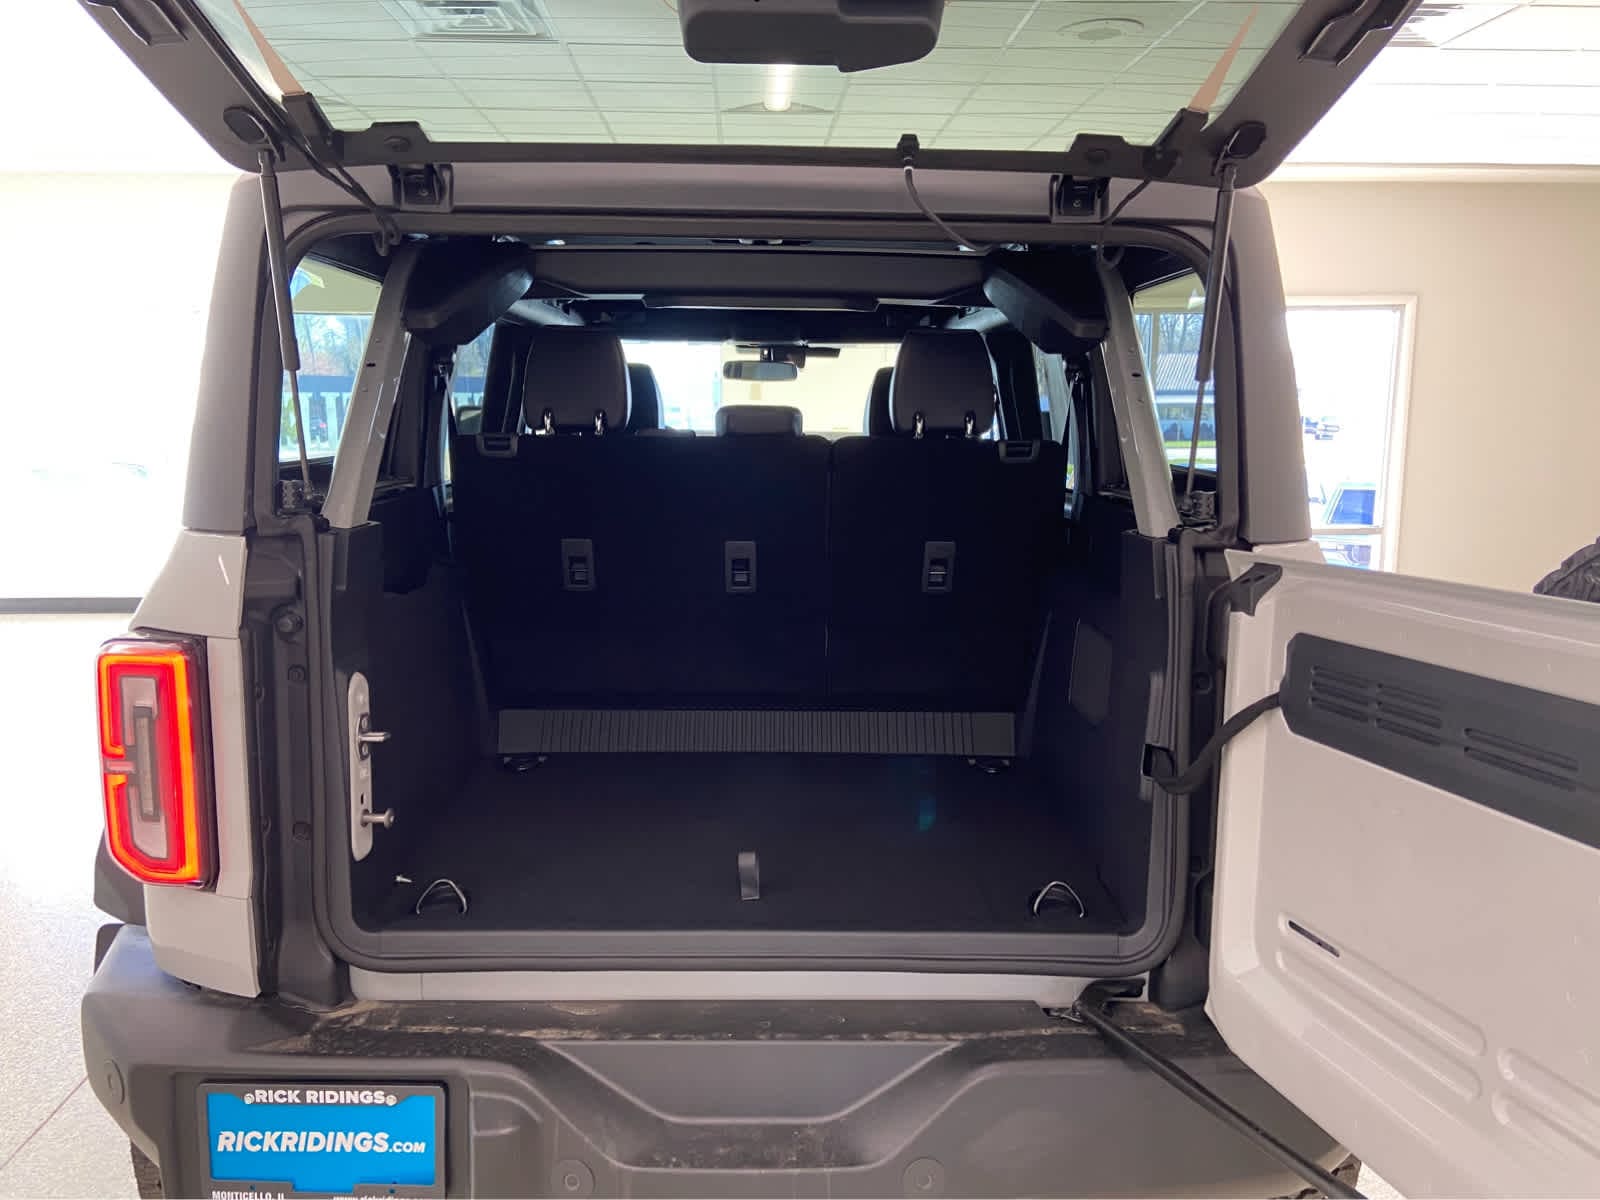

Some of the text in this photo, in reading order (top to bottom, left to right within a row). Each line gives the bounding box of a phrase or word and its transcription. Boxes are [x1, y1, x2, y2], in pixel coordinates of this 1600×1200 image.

[255, 1090, 385, 1104] RICK RIDINGS
[217, 1131, 426, 1153] RICKRIDINGS.COM
